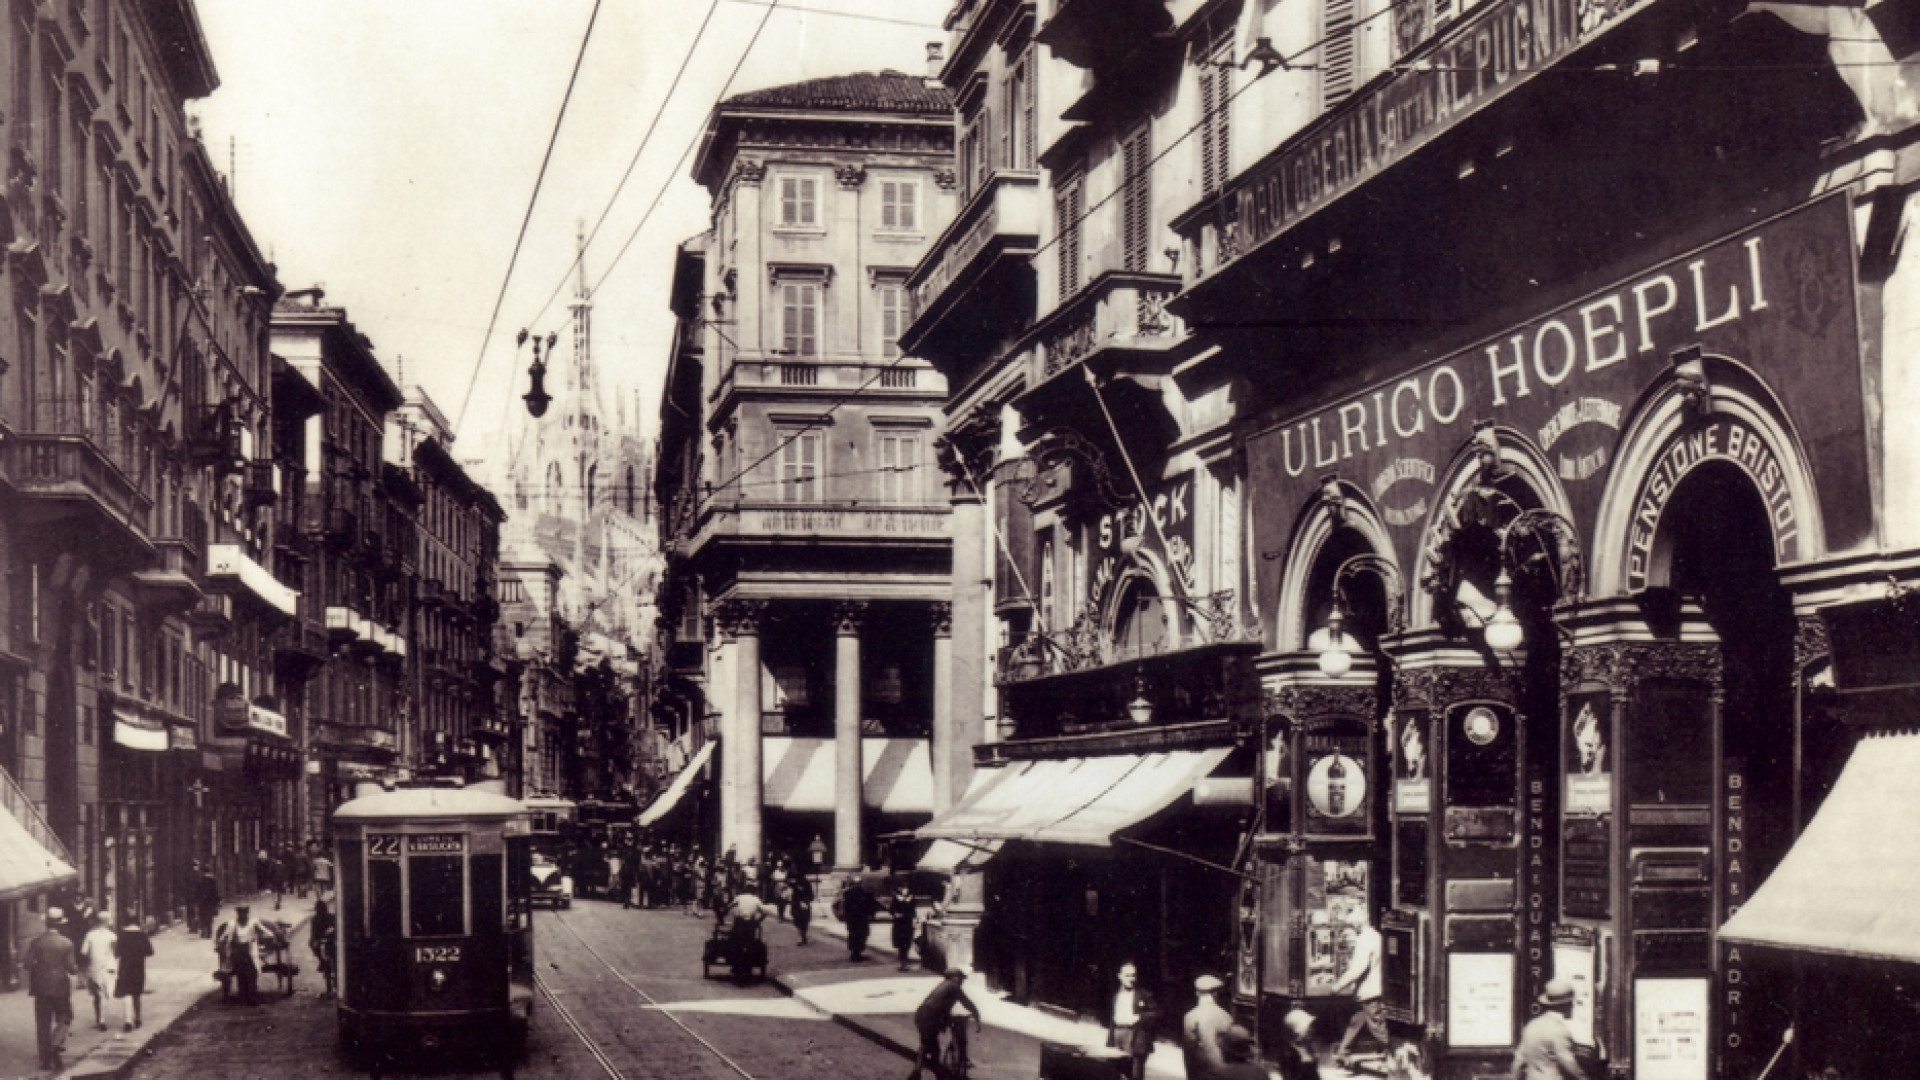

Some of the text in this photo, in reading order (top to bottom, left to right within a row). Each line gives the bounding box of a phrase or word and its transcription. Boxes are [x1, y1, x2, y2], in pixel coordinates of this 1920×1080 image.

[1282, 236, 1770, 478] ULRICO HOEPLI
[1098, 481, 1189, 550] STOCK
[1630, 423, 1798, 577] PENSIONE BRISTOL
[371, 836, 398, 855] 22
[1530, 781, 1543, 867] BENDA
[1728, 775, 1742, 873] BENDA
[1529, 892, 1543, 1016] QUADRIO
